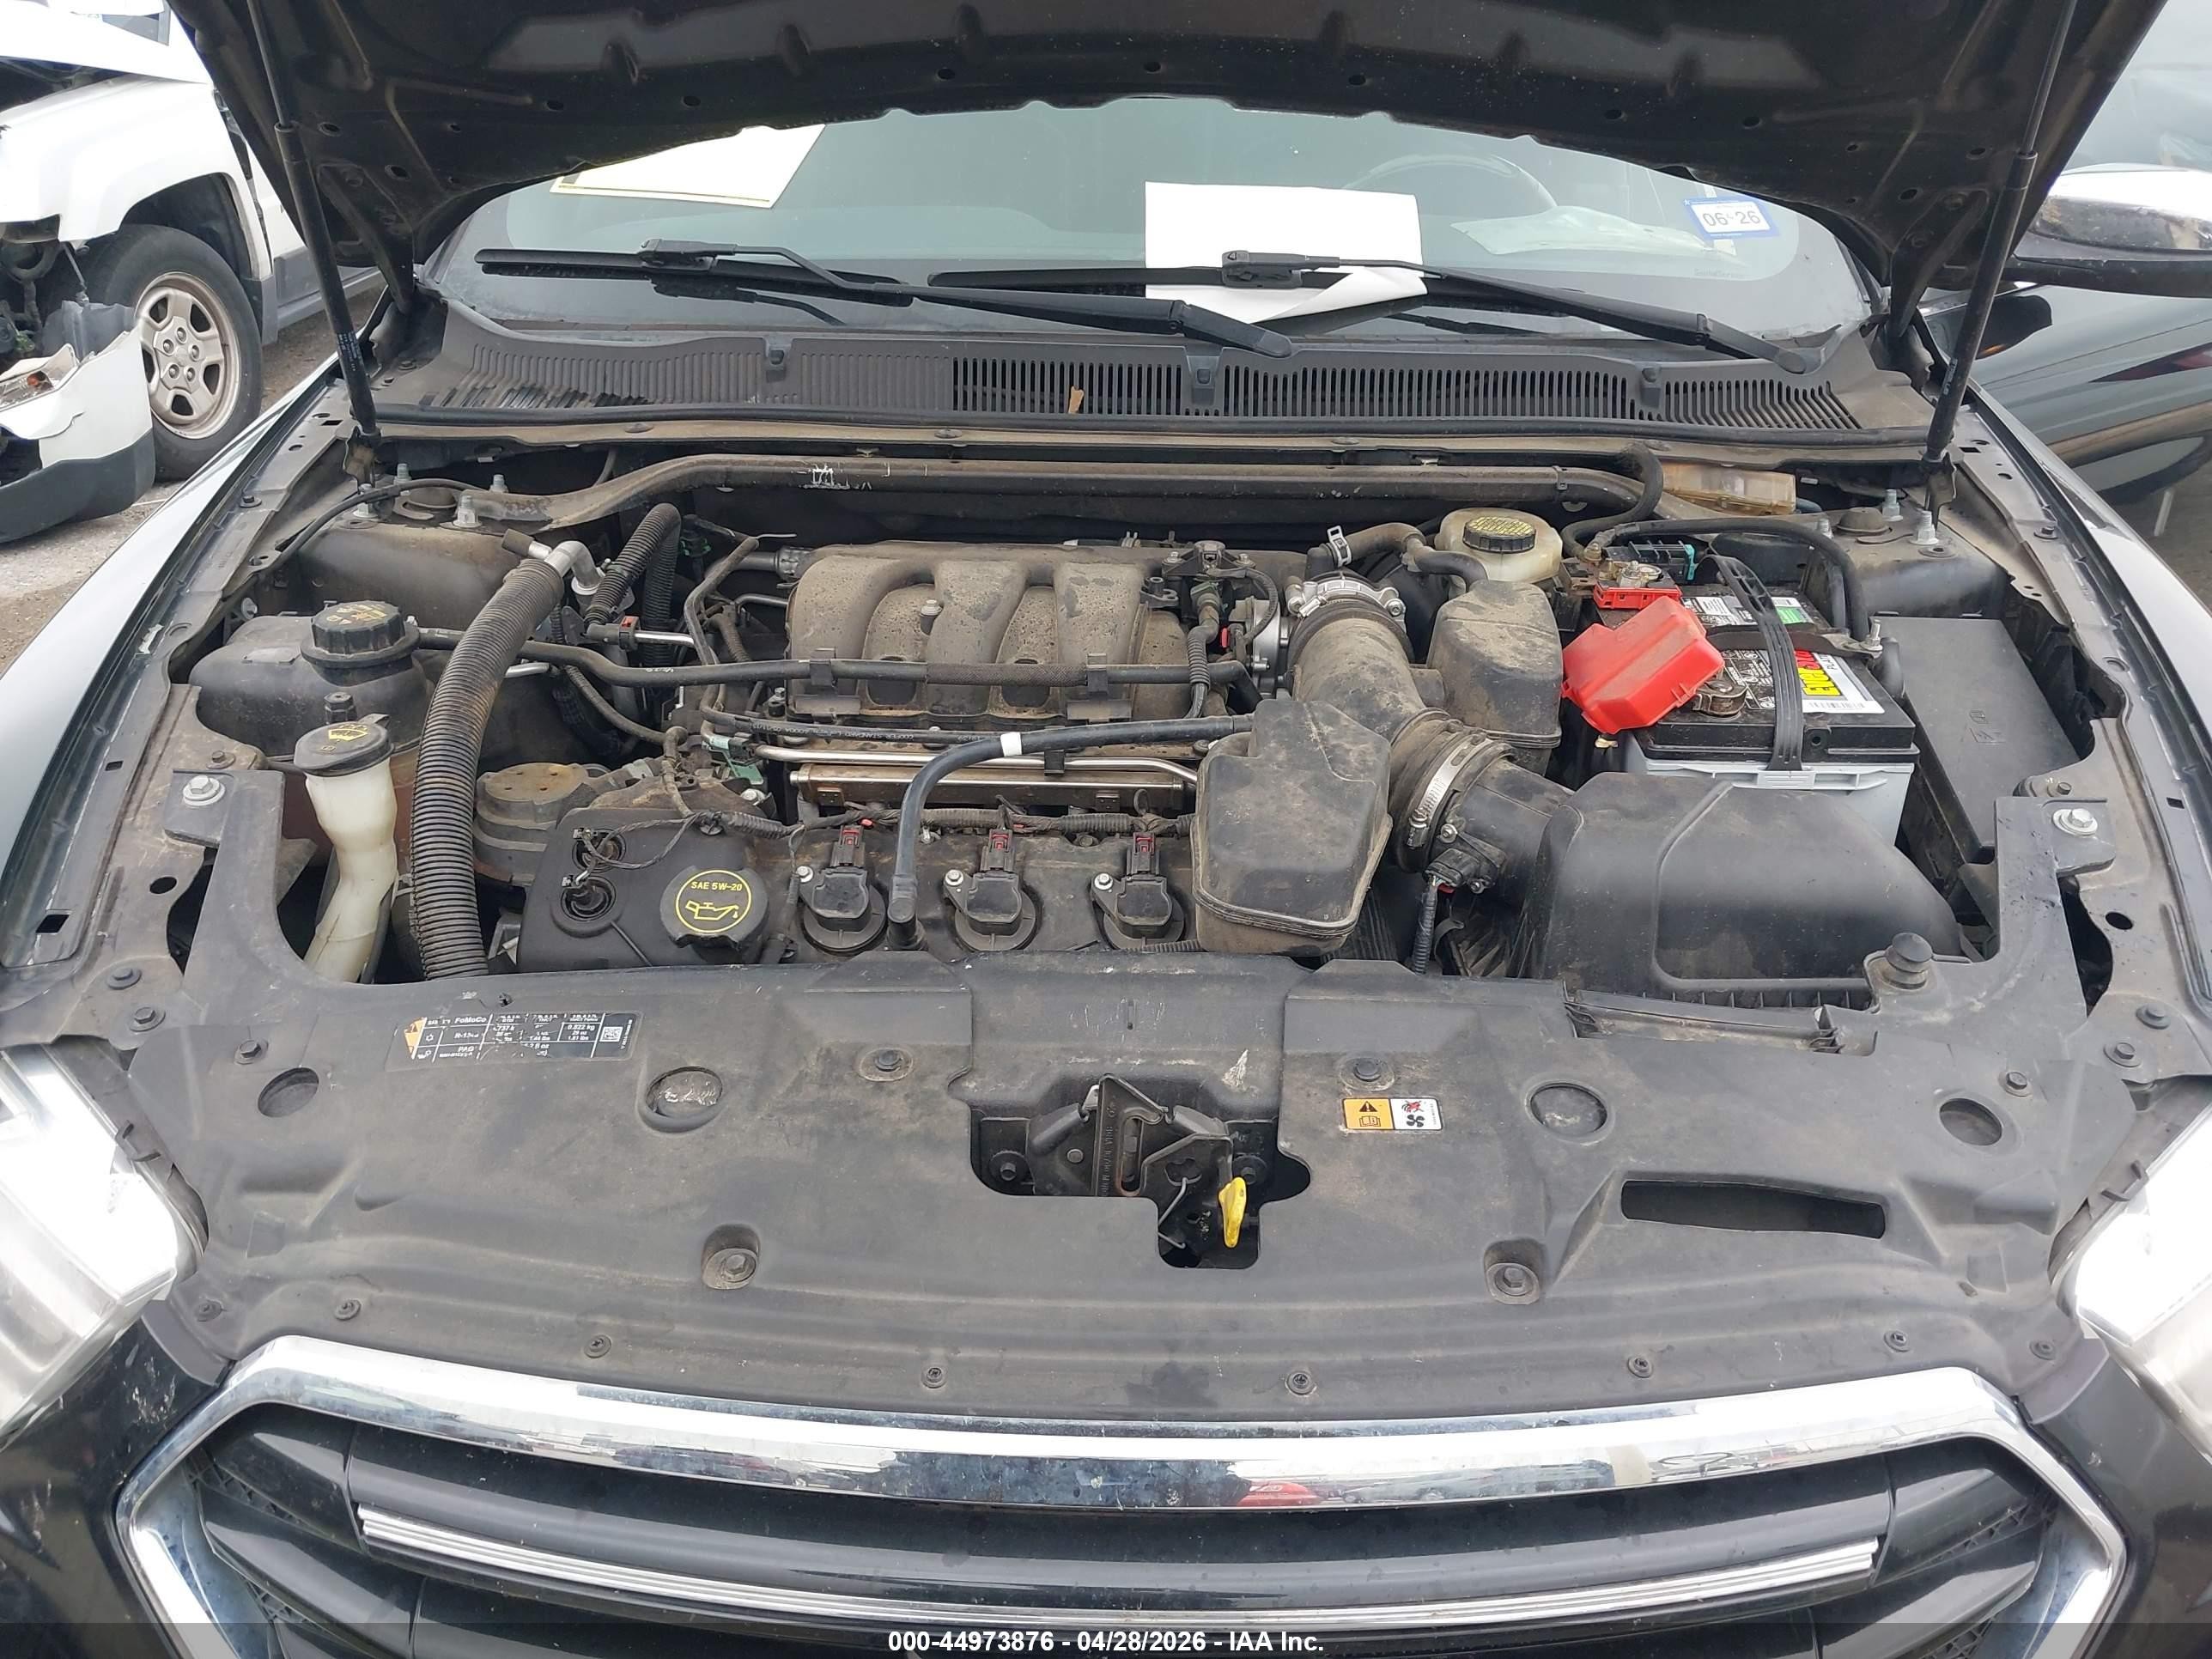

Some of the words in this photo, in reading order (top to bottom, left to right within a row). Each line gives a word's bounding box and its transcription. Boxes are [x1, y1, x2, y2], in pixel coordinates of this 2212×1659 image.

[1702, 212, 1729, 227] 06
[1735, 210, 1761, 225] 26
[690, 881, 709, 890] SAE
[712, 882, 743, 891] 5W-20
